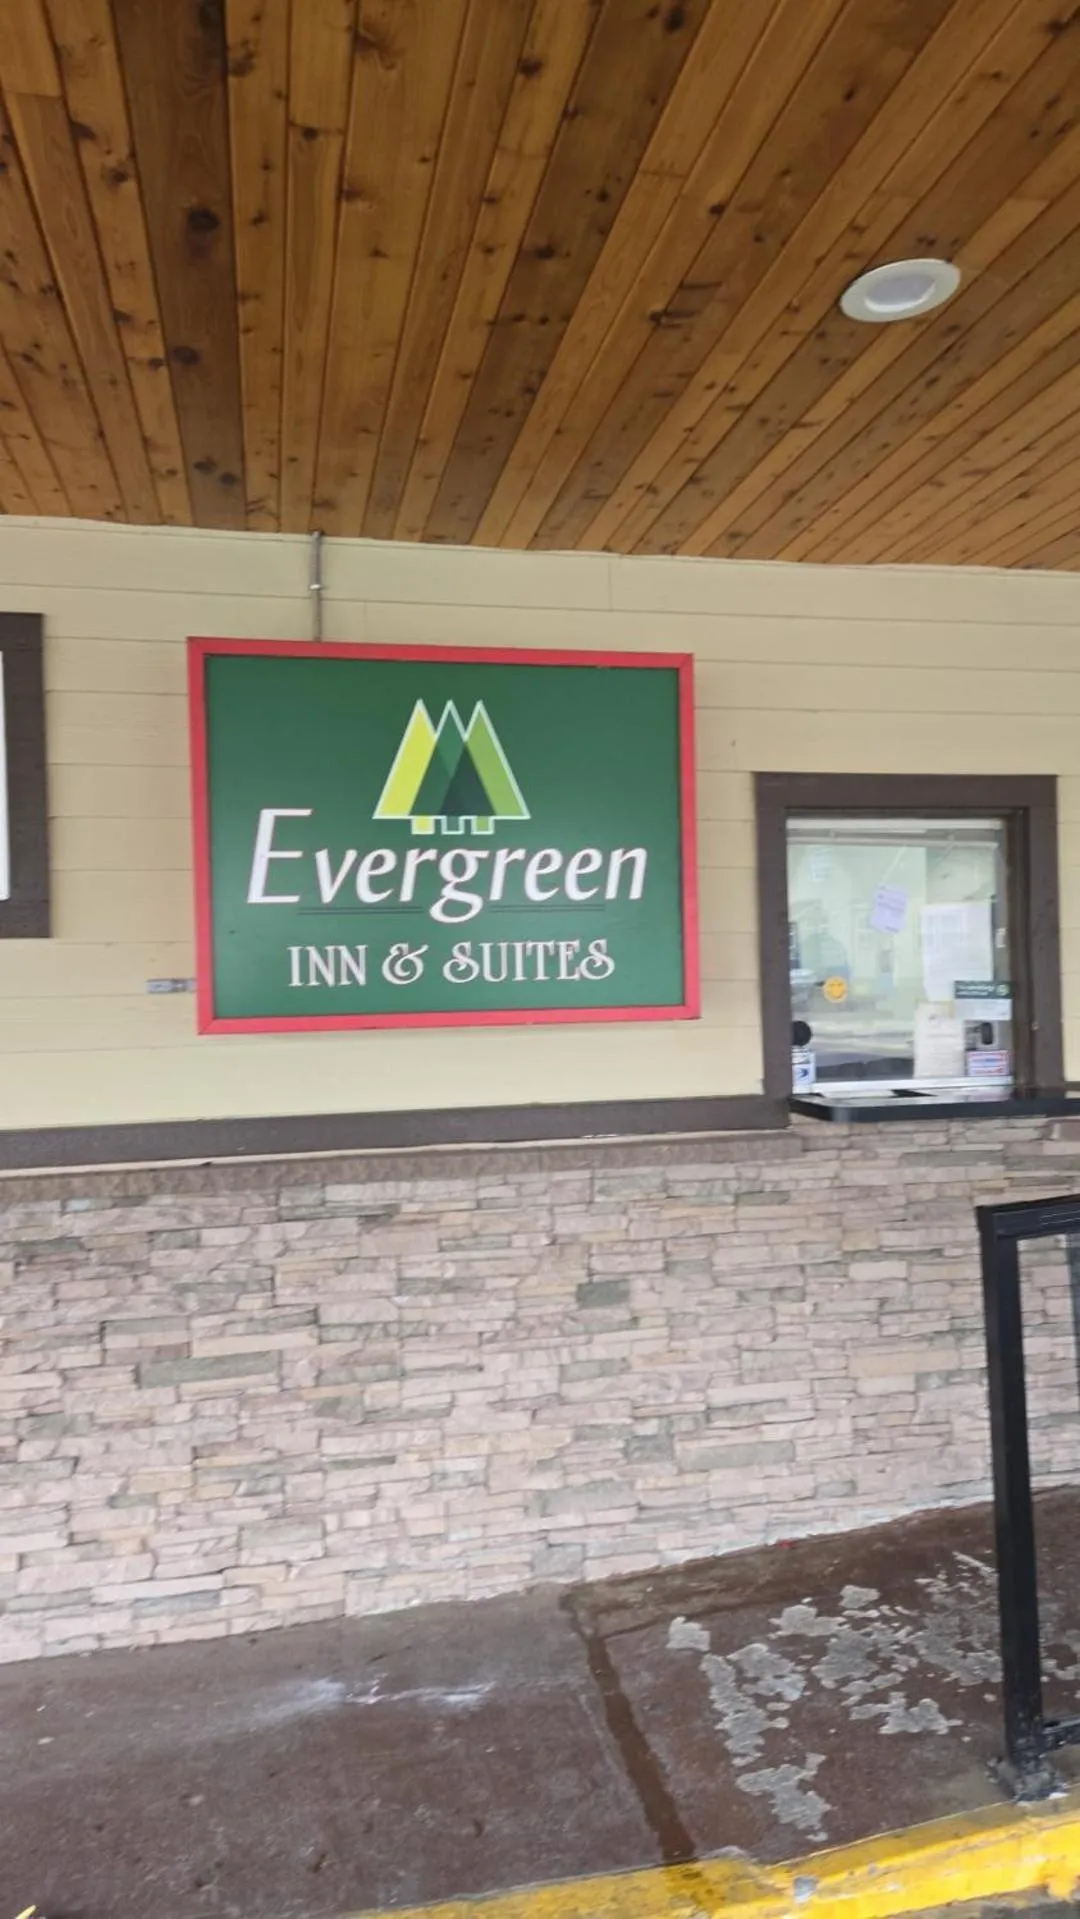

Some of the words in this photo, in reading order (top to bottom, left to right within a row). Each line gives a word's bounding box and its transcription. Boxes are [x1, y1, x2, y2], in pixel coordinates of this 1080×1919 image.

[247, 808, 647, 923] Evergreen
[287, 945, 367, 987] INN
[382, 943, 428, 985] &
[442, 939, 615, 983] SUITES
